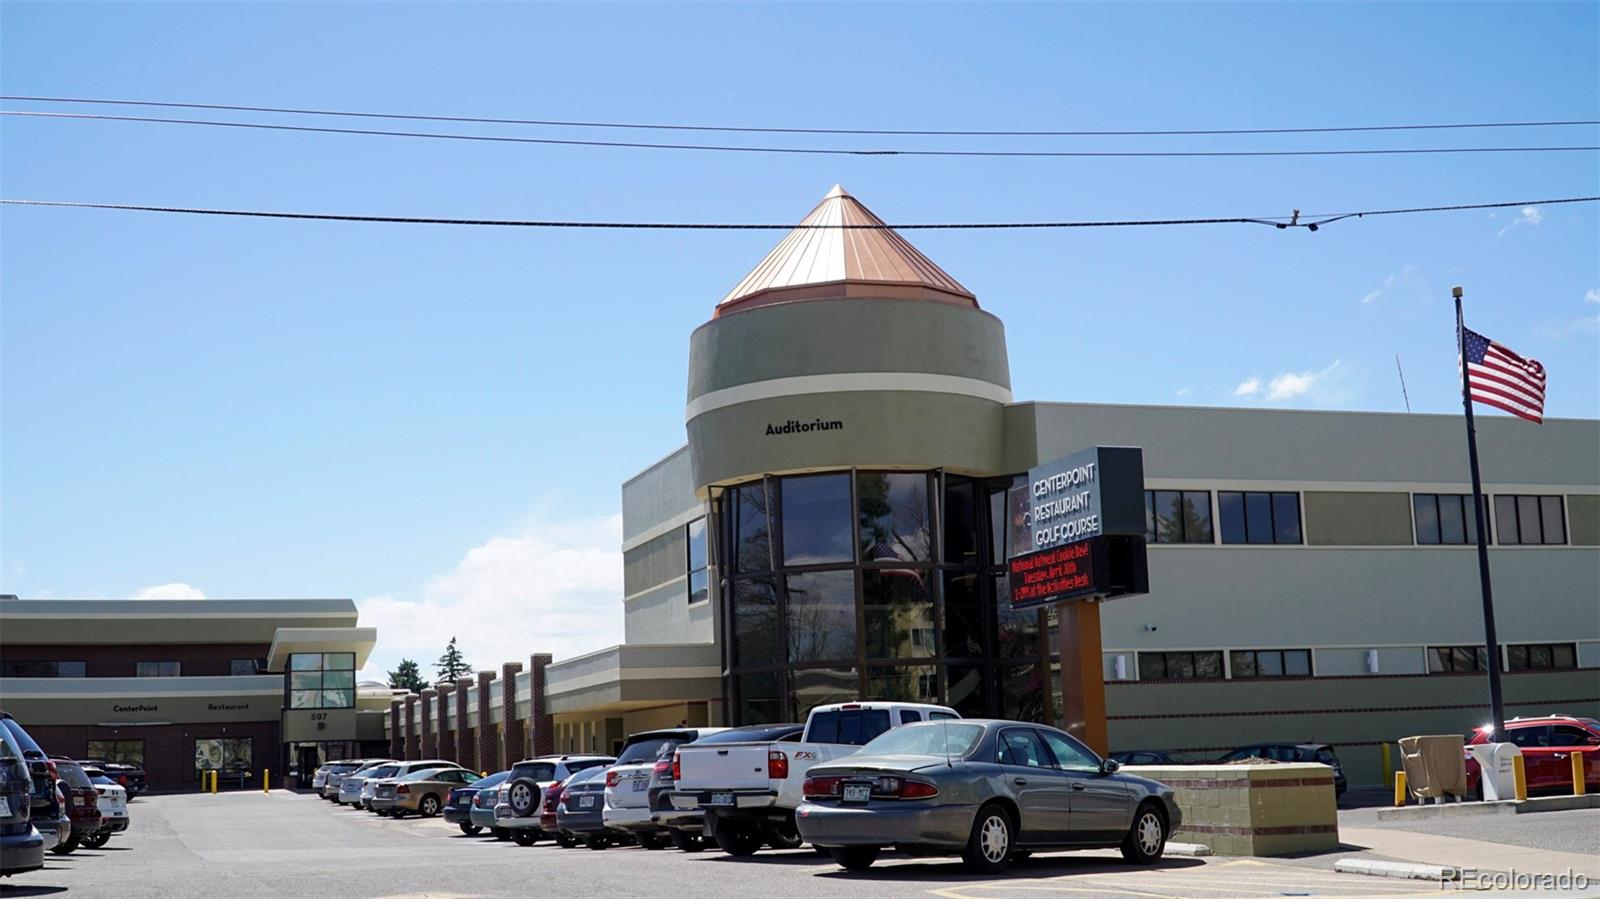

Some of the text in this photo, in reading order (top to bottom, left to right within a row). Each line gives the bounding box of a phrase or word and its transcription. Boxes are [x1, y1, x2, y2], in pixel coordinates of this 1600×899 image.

[766, 419, 843, 436] Auditorium
[1033, 463, 1096, 497] CENTERPOINT
[1035, 491, 1090, 521] RESTAURANT
[1036, 515, 1098, 545] GOLF COURSE
[113, 703, 249, 713] CenterPoint Restaurant
[311, 713, 328, 721] 597
